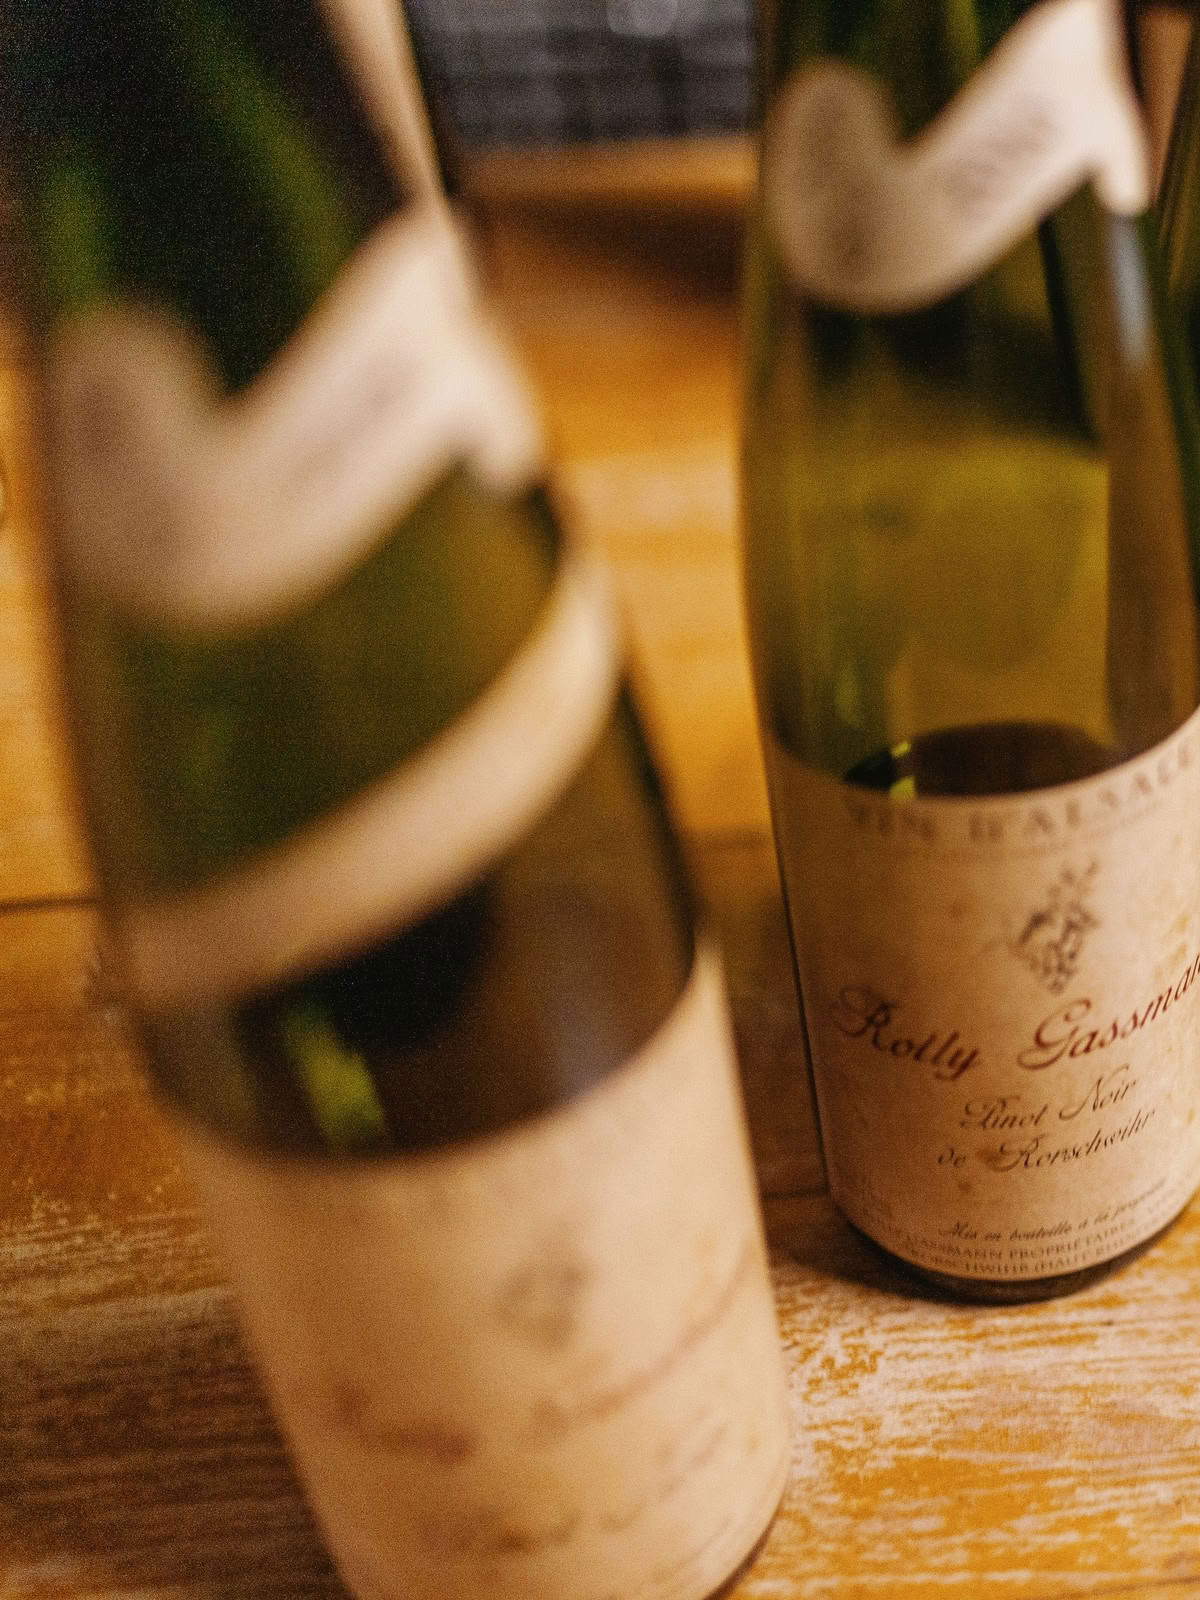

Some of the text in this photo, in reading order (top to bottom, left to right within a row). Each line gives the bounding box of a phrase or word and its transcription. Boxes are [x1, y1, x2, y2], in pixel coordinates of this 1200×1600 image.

[833, 984, 981, 1081] Rolly
[958, 1063, 1137, 1130] Pinot Noir
[937, 1147, 967, 1168] de
